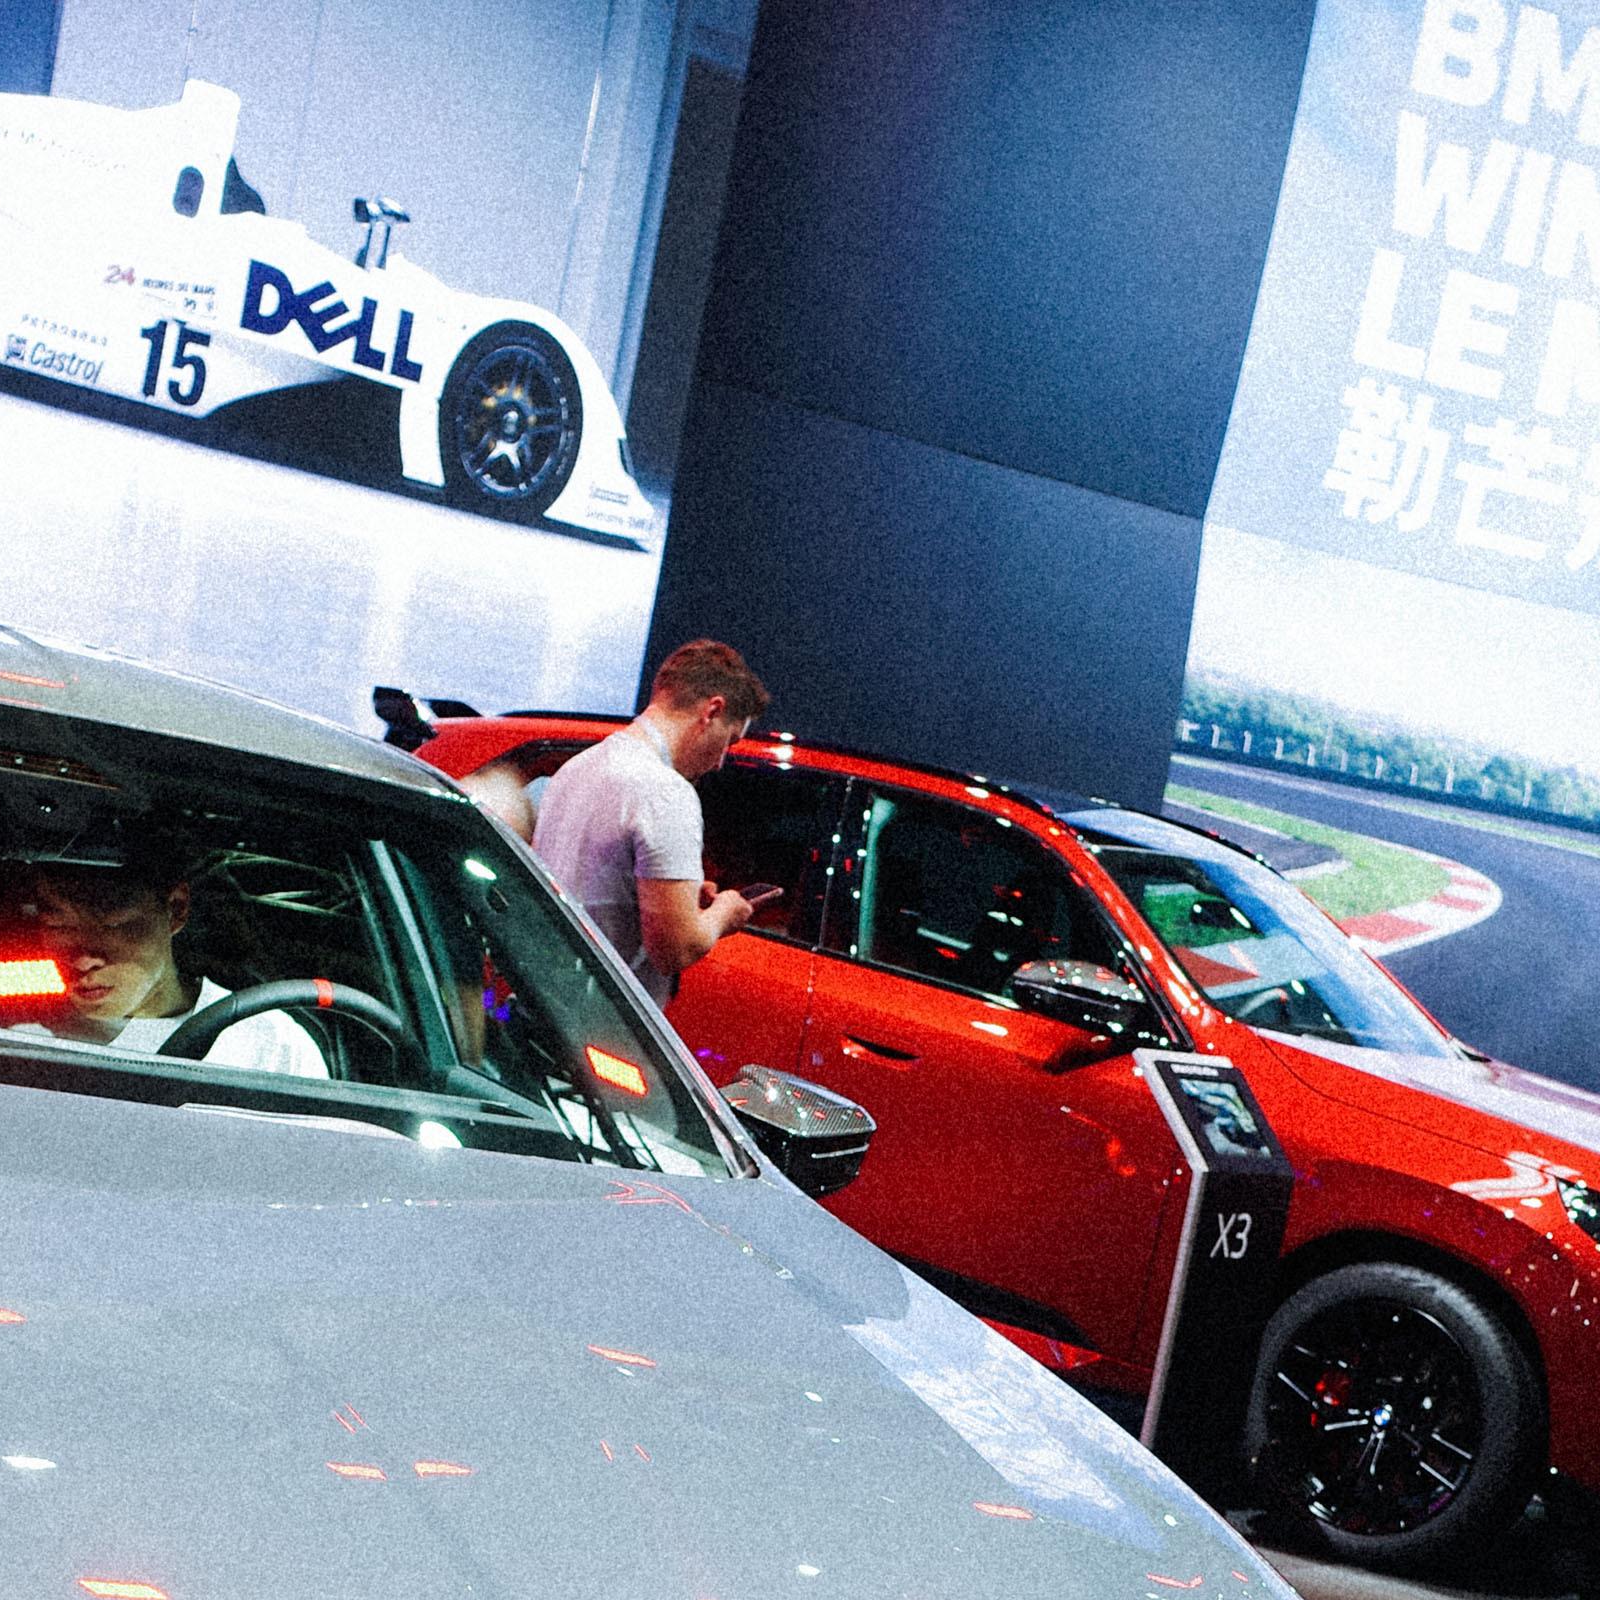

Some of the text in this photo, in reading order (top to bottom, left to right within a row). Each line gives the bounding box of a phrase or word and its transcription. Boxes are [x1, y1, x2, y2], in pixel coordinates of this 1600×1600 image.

[103, 263, 136, 286] 24
[240, 258, 424, 384] DELL
[1351, 246, 1521, 400] LE
[29, 340, 105, 384] Castrol
[140, 318, 212, 406] 15
[1209, 1211, 1253, 1260] X3
